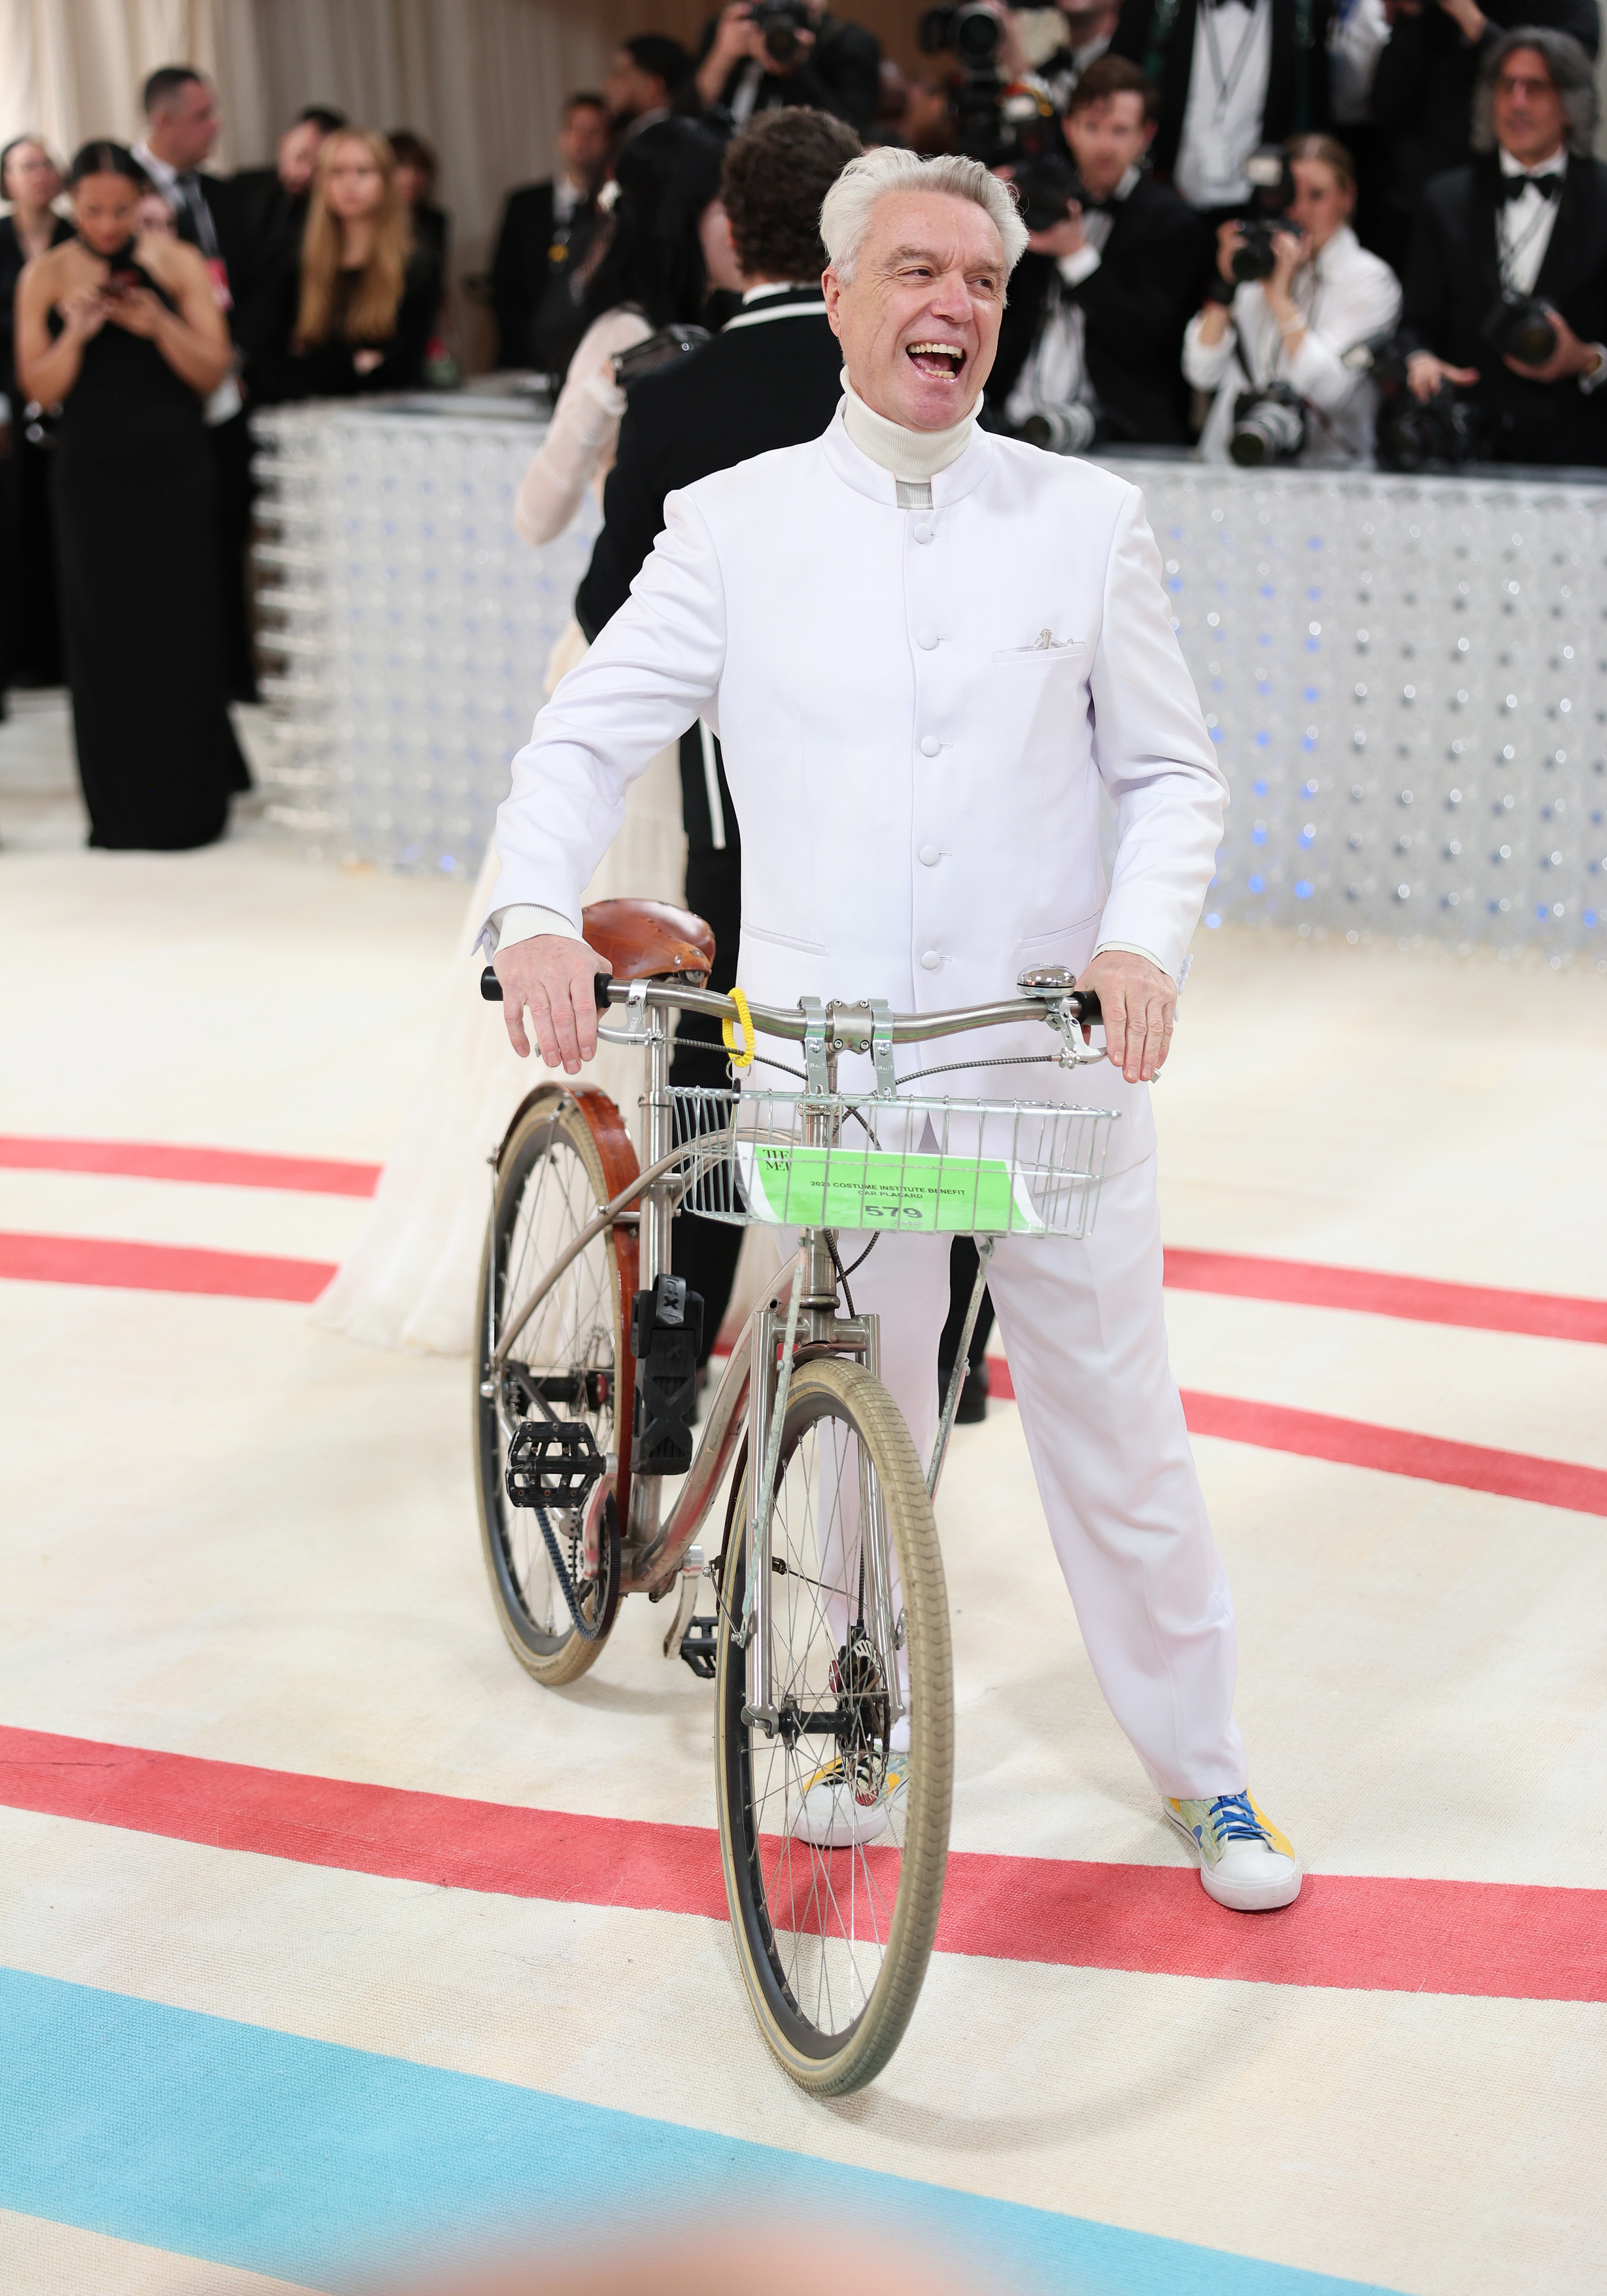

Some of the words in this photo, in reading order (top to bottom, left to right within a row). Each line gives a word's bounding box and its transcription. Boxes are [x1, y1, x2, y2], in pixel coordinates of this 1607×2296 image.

[763, 1149, 790, 1159] THE
[880, 1185, 926, 1193] INSTTUTE
[865, 1205, 923, 1219] 579
